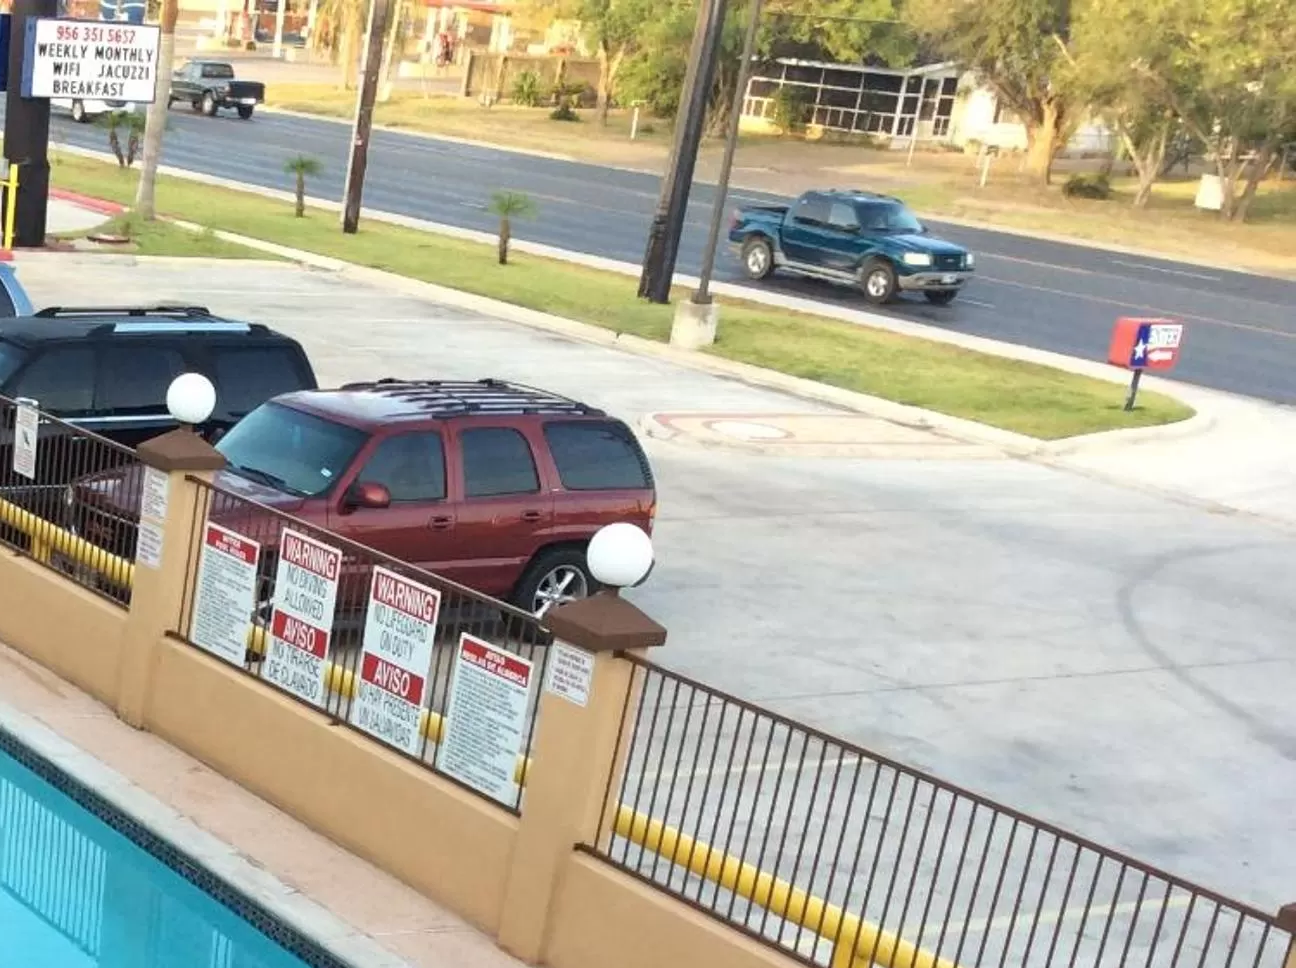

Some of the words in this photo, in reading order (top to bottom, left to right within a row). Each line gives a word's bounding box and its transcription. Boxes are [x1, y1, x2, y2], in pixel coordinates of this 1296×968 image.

[56, 25, 79, 41] 956
[84, 26, 104, 42] 351
[38, 43, 88, 60] WEEKLY
[95, 45, 154, 62] MONTHLY
[53, 62, 81, 76] WIFI
[98, 64, 150, 80] JACUZZI
[53, 79, 125, 97] BREAKFAST
[286, 535, 336, 578] WARNING
[285, 588, 324, 621] ALLOWED
[376, 574, 434, 621] WARNING
[283, 617, 316, 651] AVISO
[373, 660, 410, 697] AVISO
